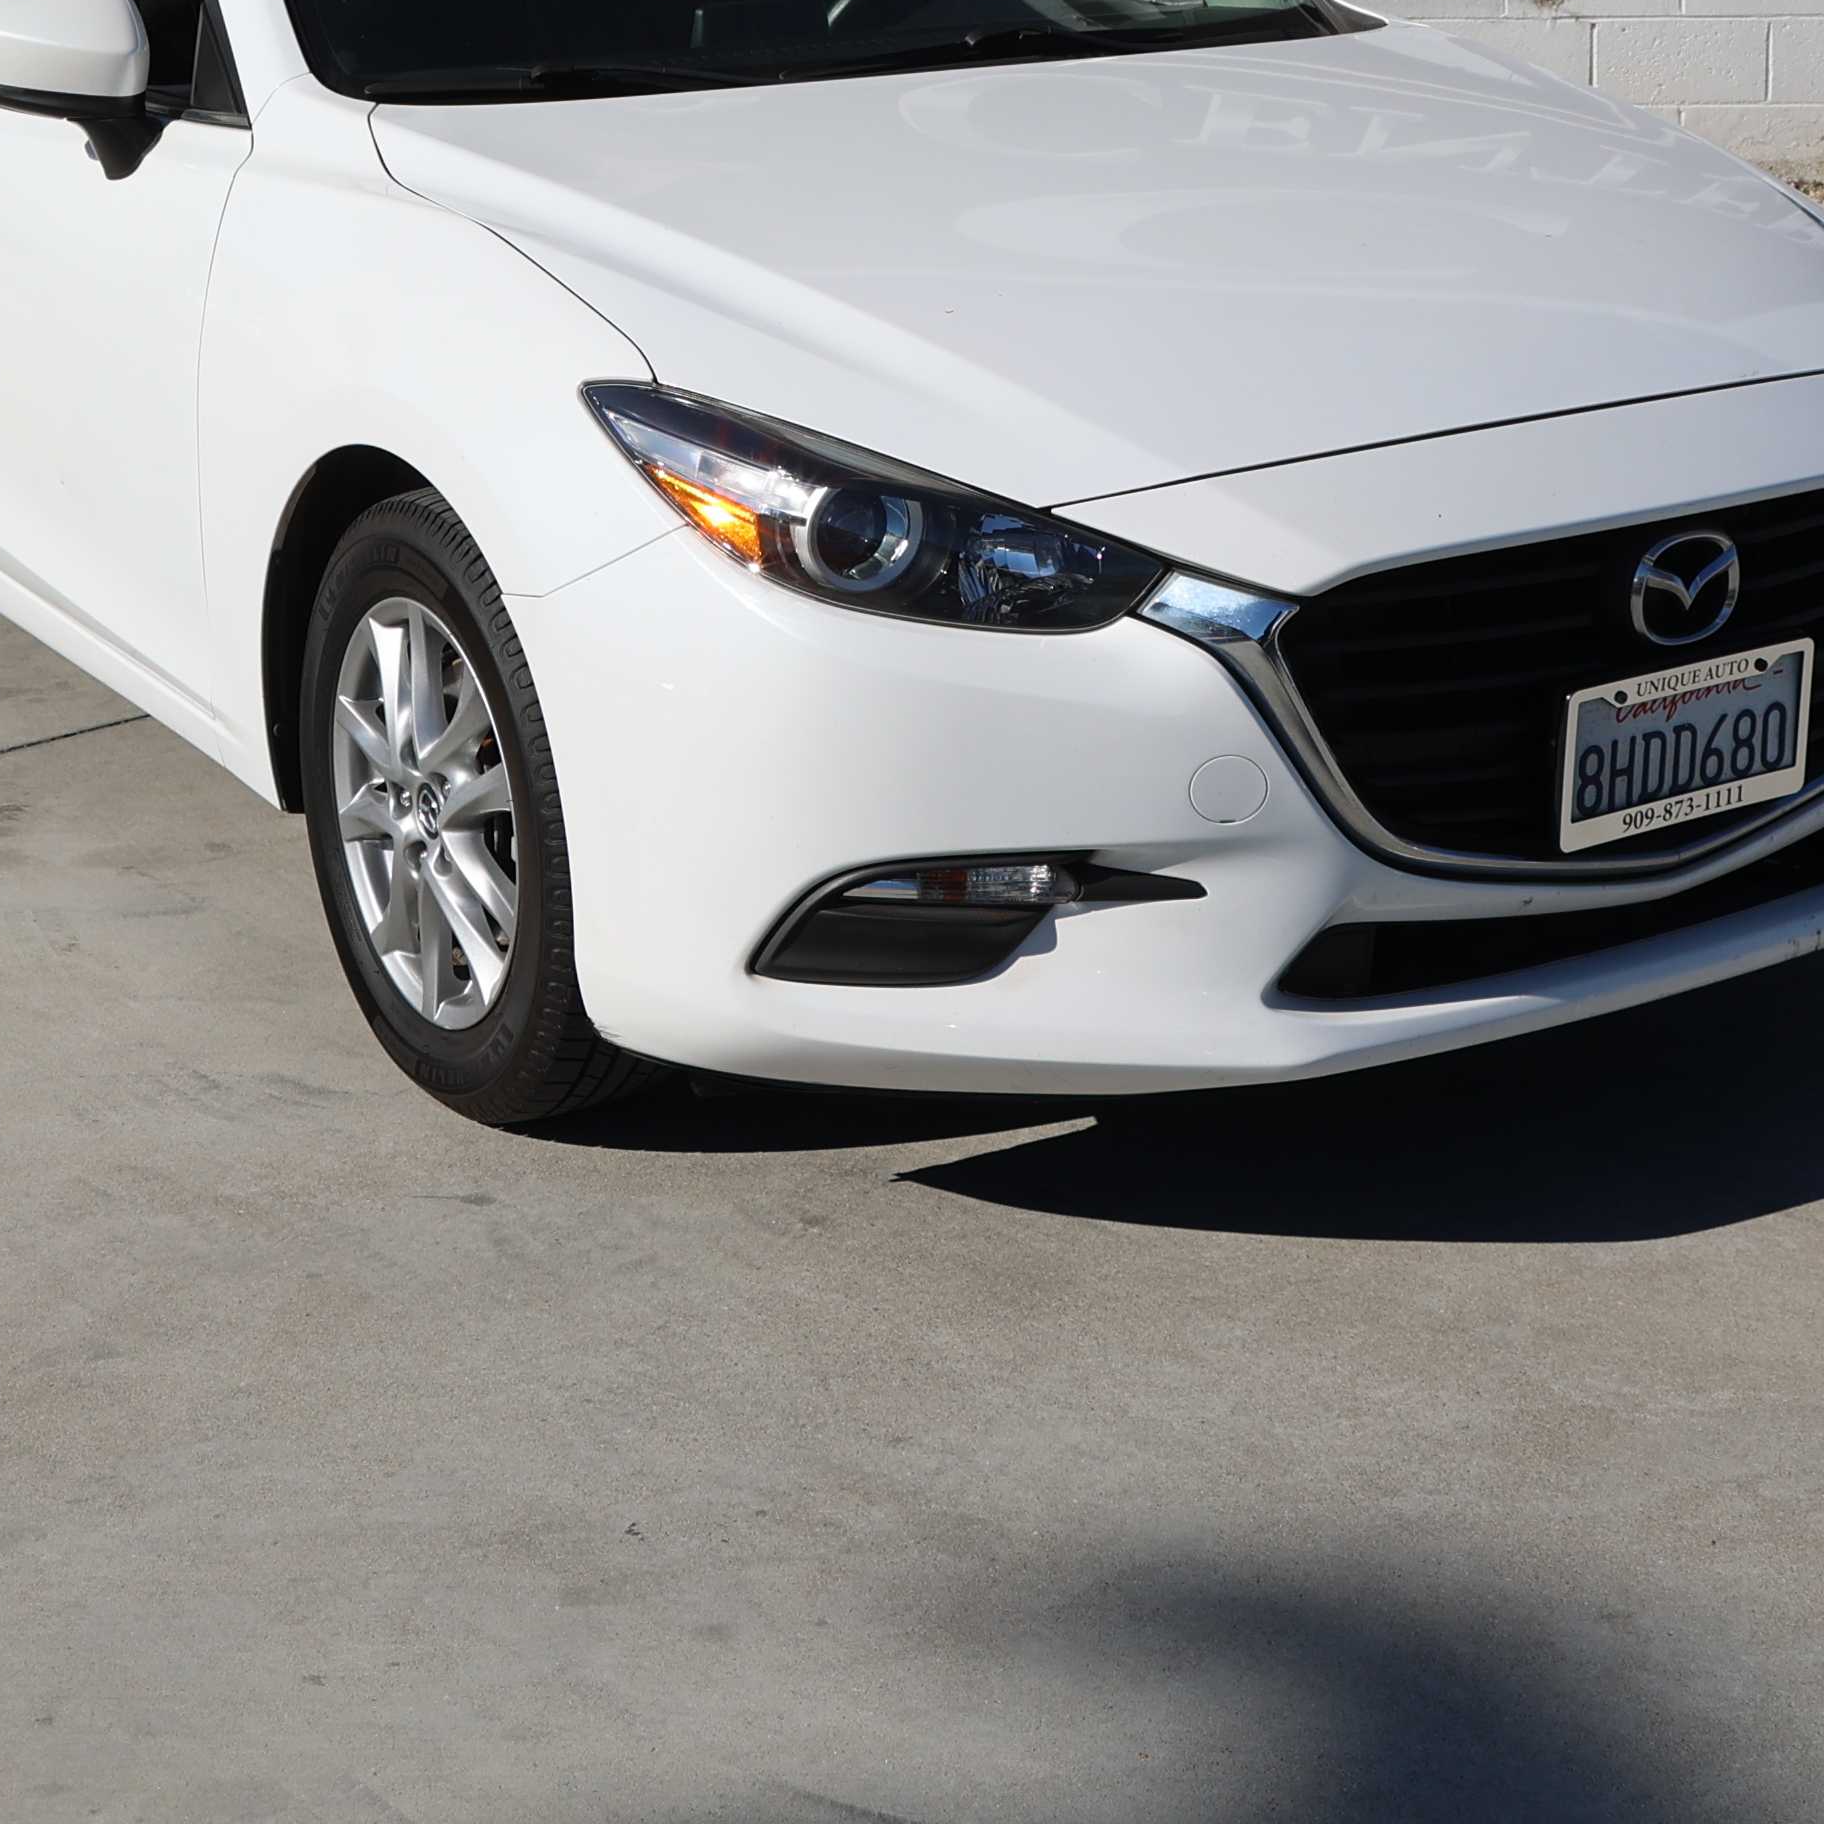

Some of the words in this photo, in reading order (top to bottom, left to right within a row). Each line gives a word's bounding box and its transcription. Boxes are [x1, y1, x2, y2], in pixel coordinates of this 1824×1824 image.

[1636, 668, 1702, 698] UNIQUE
[1703, 658, 1750, 682] AUTO
[1577, 701, 1787, 817] 8HDD680
[1622, 784, 1744, 833] 909-873-1111
